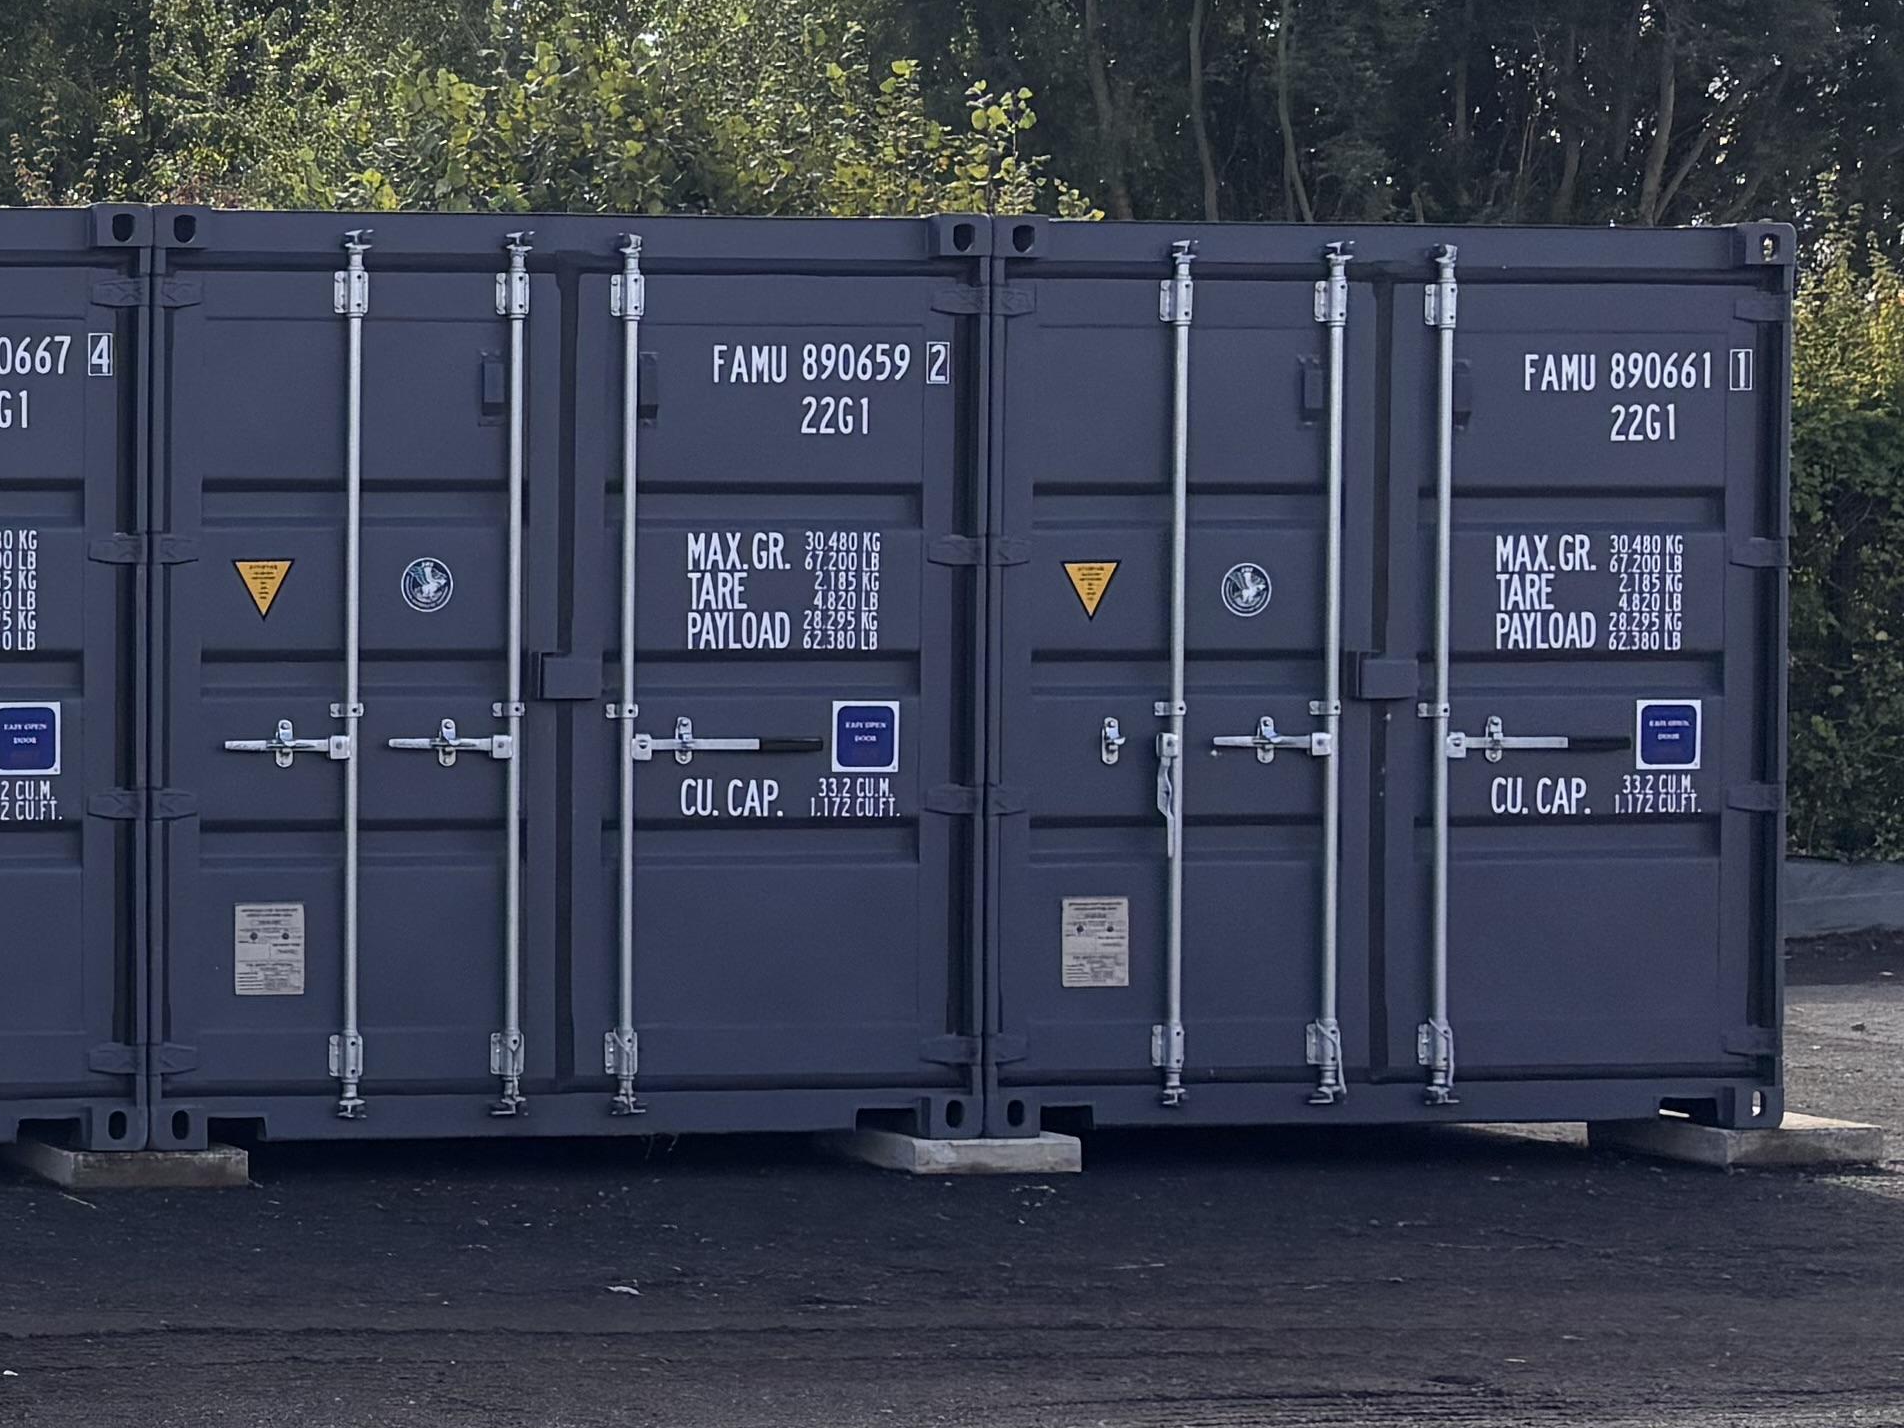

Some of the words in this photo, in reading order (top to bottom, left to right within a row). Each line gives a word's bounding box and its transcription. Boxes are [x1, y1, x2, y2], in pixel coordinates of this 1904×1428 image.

[92, 335, 109, 374] 4
[713, 345, 787, 383] FAMU
[802, 344, 910, 381] 890659
[929, 344, 946, 381] 2
[1525, 354, 1595, 391] FAMU
[1610, 352, 1711, 389] 890661
[801, 396, 869, 434] 22G1
[1610, 404, 1675, 441] 22G1
[19, 530, 37, 550] KG
[863, 532, 880, 552] KG
[1665, 535, 1683, 554] KG
[18, 551, 36, 569] LB
[862, 552, 879, 571] LB
[1665, 555, 1682, 573] LB
[18, 571, 37, 590] KG
[814, 572, 856, 590] 2.185
[862, 572, 879, 591] KG
[1619, 574, 1660, 592] 2.185
[1665, 574, 1683, 592] KG
[17, 591, 36, 610] LB
[687, 572, 748, 610] TARE
[1496, 573, 1555, 610] TARE
[862, 592, 878, 610] LB
[1665, 594, 1681, 611] LB
[17, 611, 37, 630] KG
[861, 611, 878, 630] KG
[1664, 613, 1682, 631] KG
[687, 612, 790, 650] PAYLOAD
[861, 631, 878, 650] LB
[1496, 612, 1597, 650] PAYLOAD
[17, 632, 36, 651] LB
[1664, 632, 1681, 650] LB
[16, 781, 55, 800] CU.M.
[818, 778, 850, 797] 33.2
[856, 778, 893, 797] CU.M.
[1623, 775, 1654, 793] 33.2
[1659, 775, 1694, 793] CU.M.
[681, 779, 719, 817] CU.
[727, 779, 783, 817] CAP.
[1492, 777, 1529, 814] CU.
[1537, 778, 1591, 814] CAP.
[1659, 794, 1702, 813] CU.FT.
[16, 801, 62, 820] CU.FT.
[856, 798, 900, 817] CU.FT.
